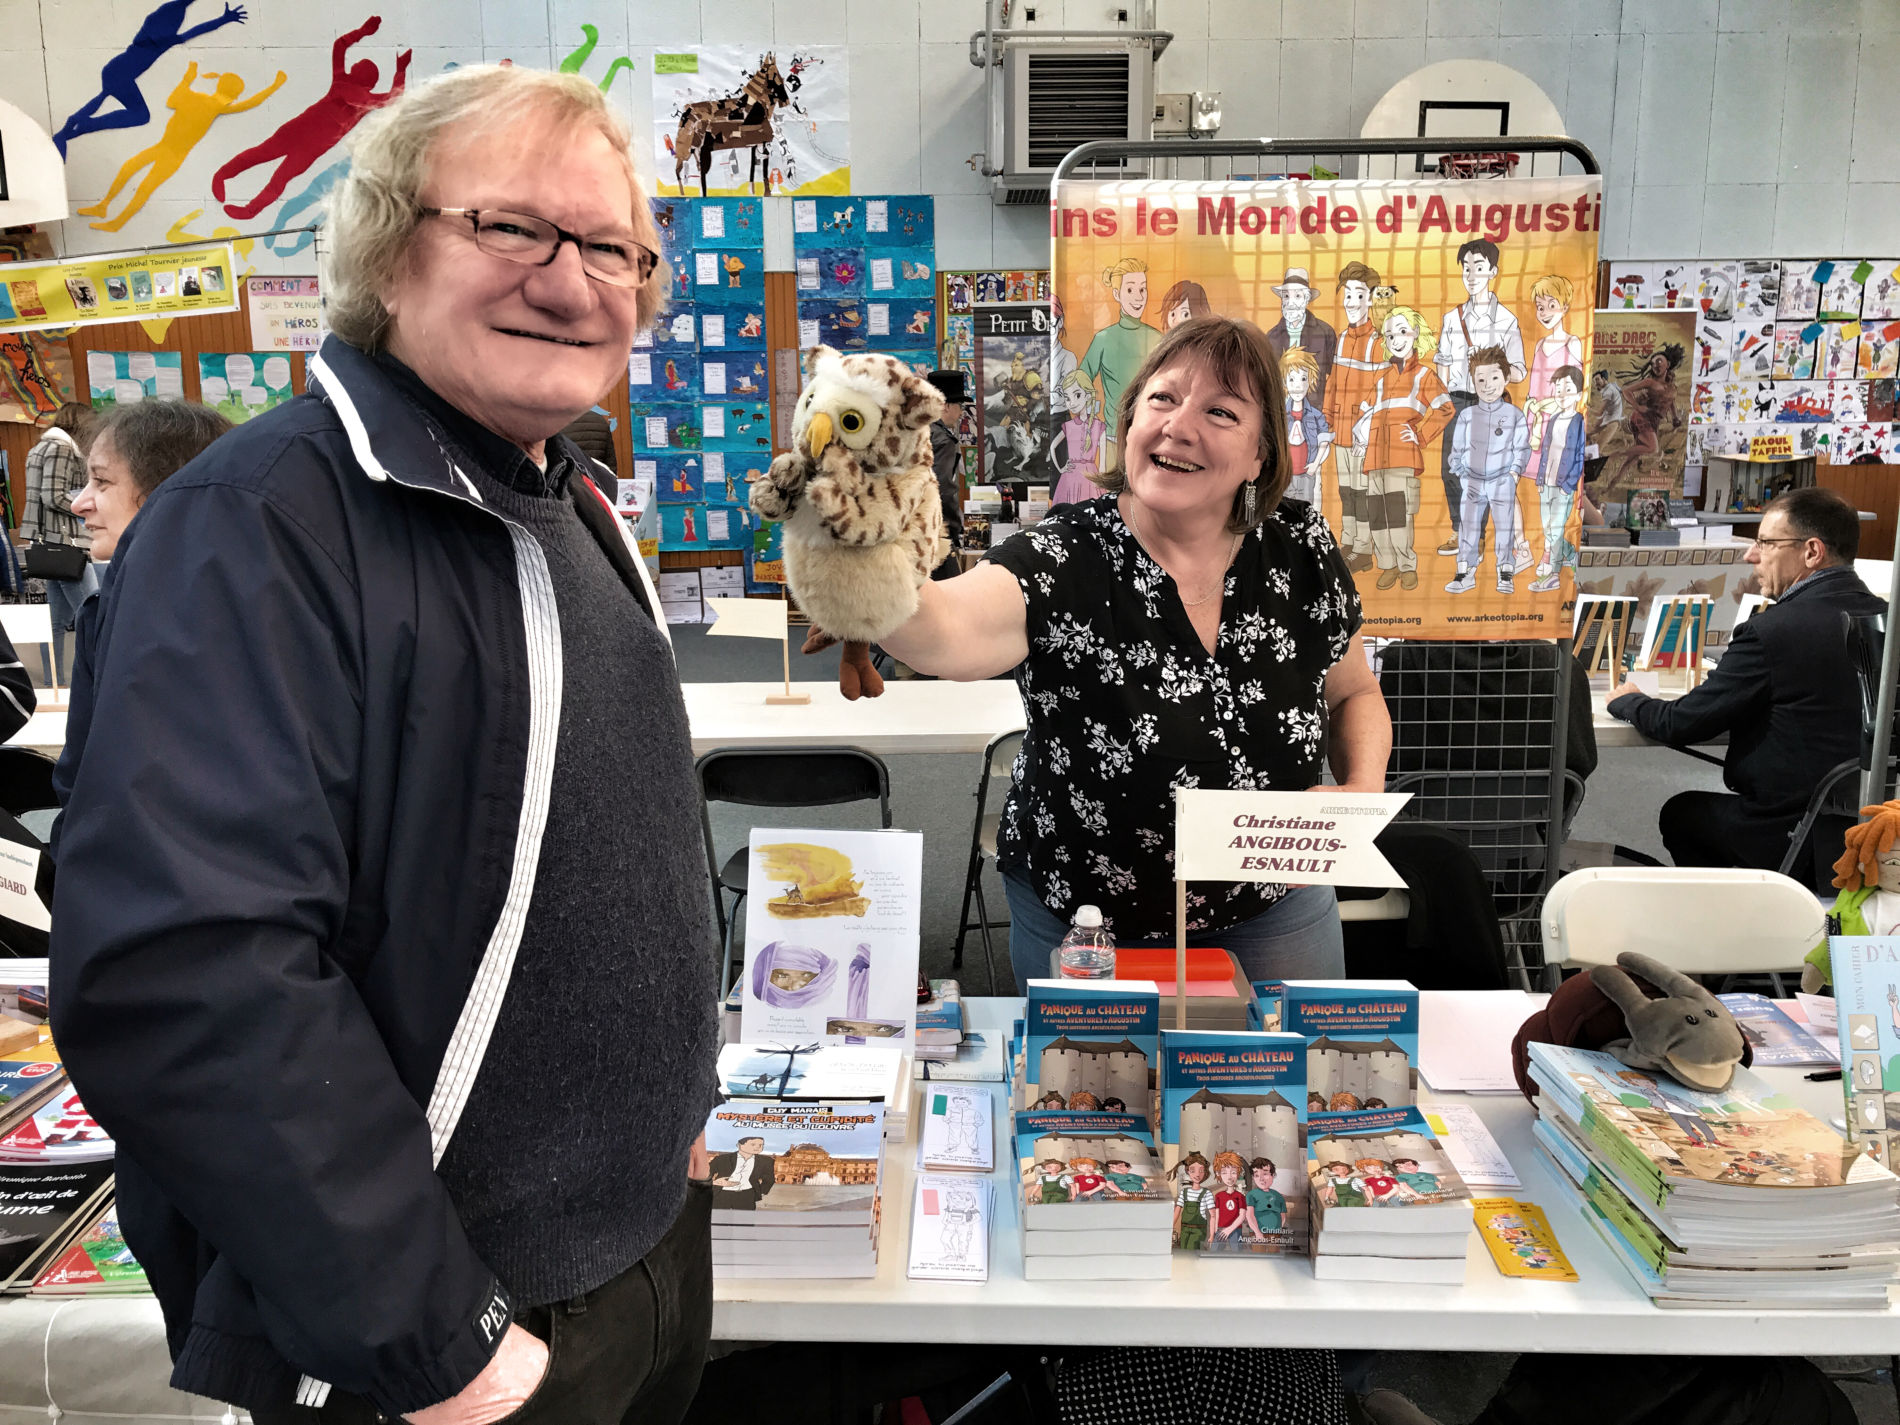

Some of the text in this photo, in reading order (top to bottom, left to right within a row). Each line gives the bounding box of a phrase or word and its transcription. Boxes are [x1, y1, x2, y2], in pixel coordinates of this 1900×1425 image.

[1137, 197, 1179, 236] le
[1197, 195, 1359, 236] Monde
[1376, 193, 1602, 243] d'Augusti
[108, 255, 207, 271] Prix Michel Tournier jeunesse
[250, 279, 302, 291] COMMENT
[989, 313, 1028, 333] PETIT
[1753, 437, 1788, 447] RAOUL
[1752, 446, 1792, 456] TAFFIN
[1446, 613, 1544, 624] www.arkeotopia.org
[1320, 806, 1388, 816] ARKEOTOPIA
[1233, 814, 1336, 831] Christiane
[1228, 835, 1347, 852] ANGIBOUS-
[1240, 856, 1336, 873] ESNAULT
[1040, 1003, 1084, 1016] PANIQUE
[1097, 1003, 1147, 1015] CHÂTEAU
[1300, 1003, 1344, 1016] PANIQUE
[1358, 1002, 1408, 1014] CHÂTEAU
[1178, 1050, 1294, 1065] PANIQUE AU CHÂTEAU
[716, 1112, 876, 1124] MYSTÈRE ET CUPIDITÉ
[752, 1122, 791, 1130] MUSÉE
[809, 1123, 856, 1131] LOUVRE
[13, 1190, 58, 1200] d'œil
[56, 1189, 79, 1198] de
[1261, 1227, 1294, 1235] Christiane
[1237, 1235, 1294, 1244] Angibous-Esnault
[480, 1295, 508, 1343] PEN
